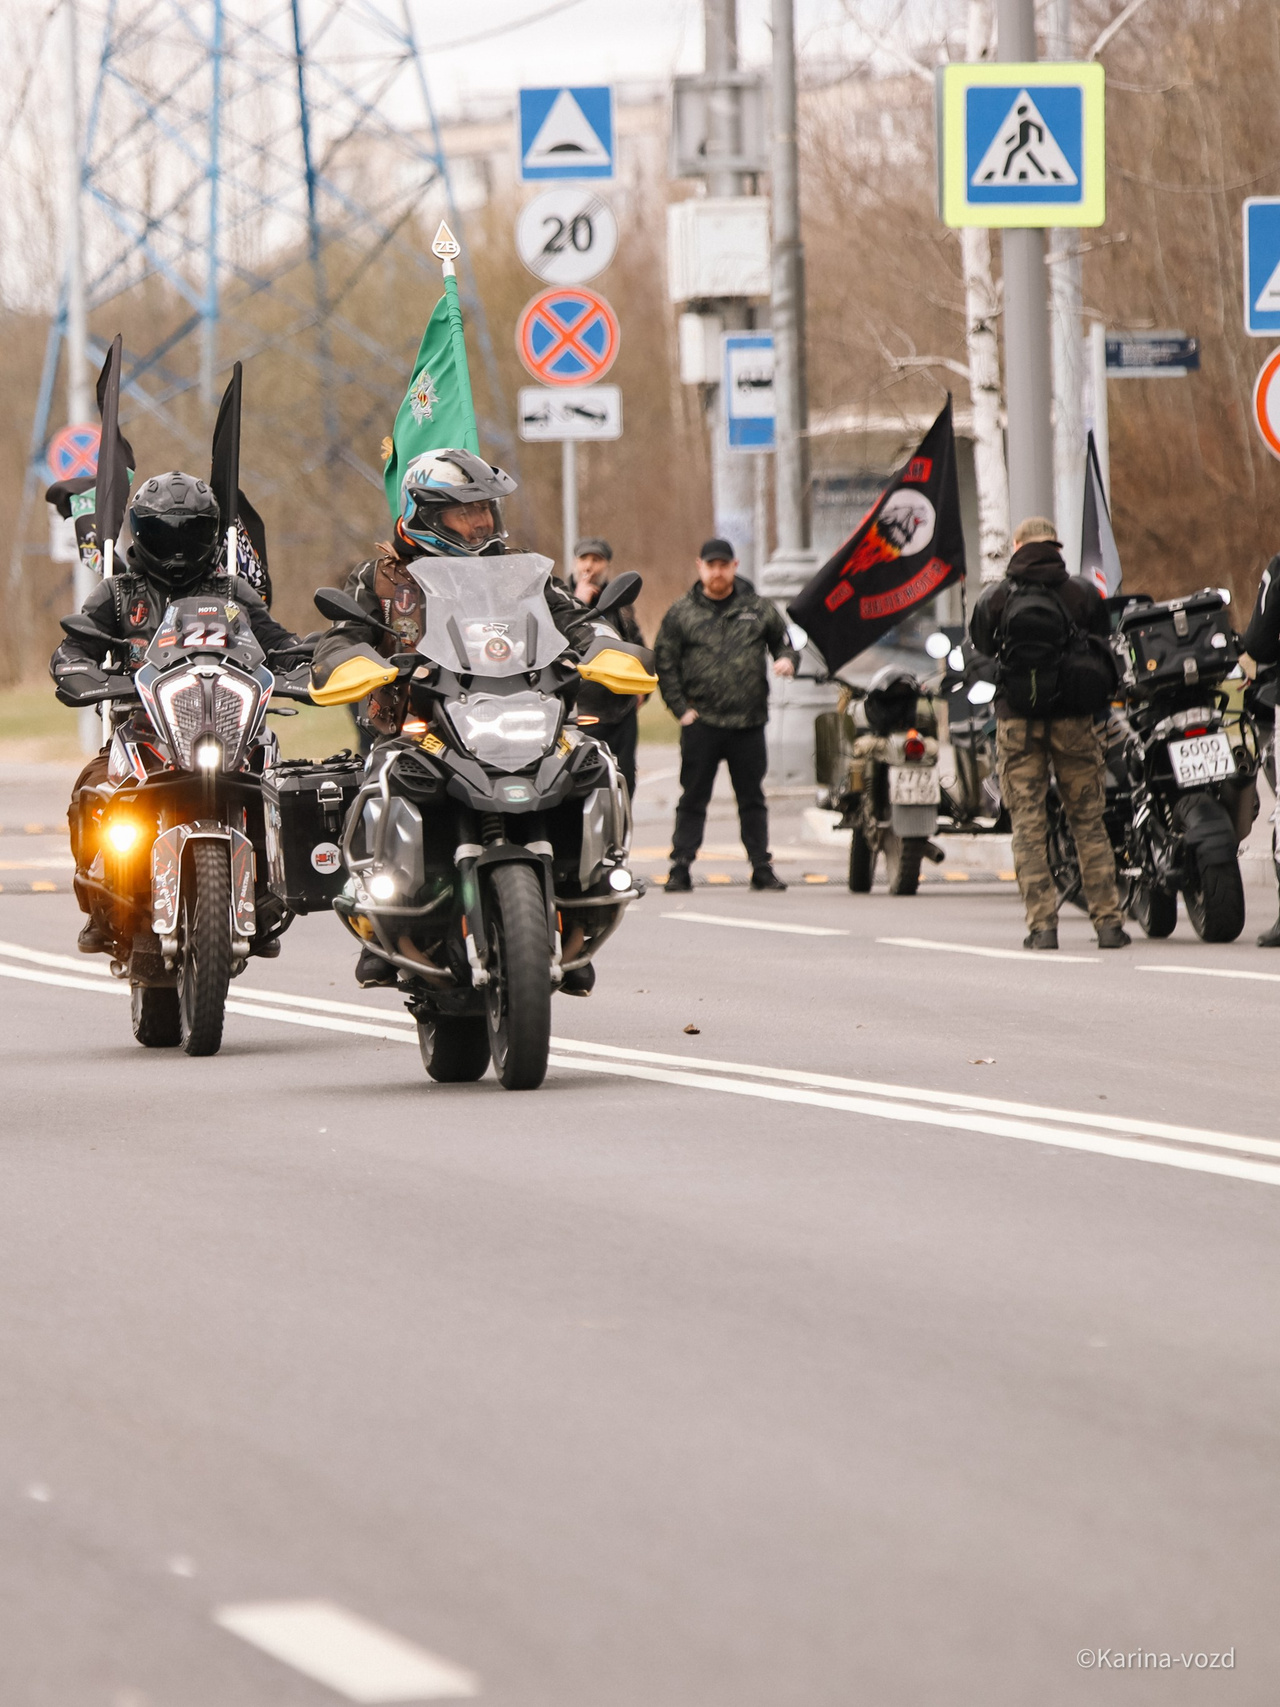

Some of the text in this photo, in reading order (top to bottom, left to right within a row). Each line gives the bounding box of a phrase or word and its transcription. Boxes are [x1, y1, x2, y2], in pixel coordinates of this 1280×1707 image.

[542, 215, 595, 253] 20
[183, 621, 227, 647] 22
[1180, 738, 1220, 758] 6000
[1209, 756, 1229, 773] 77
